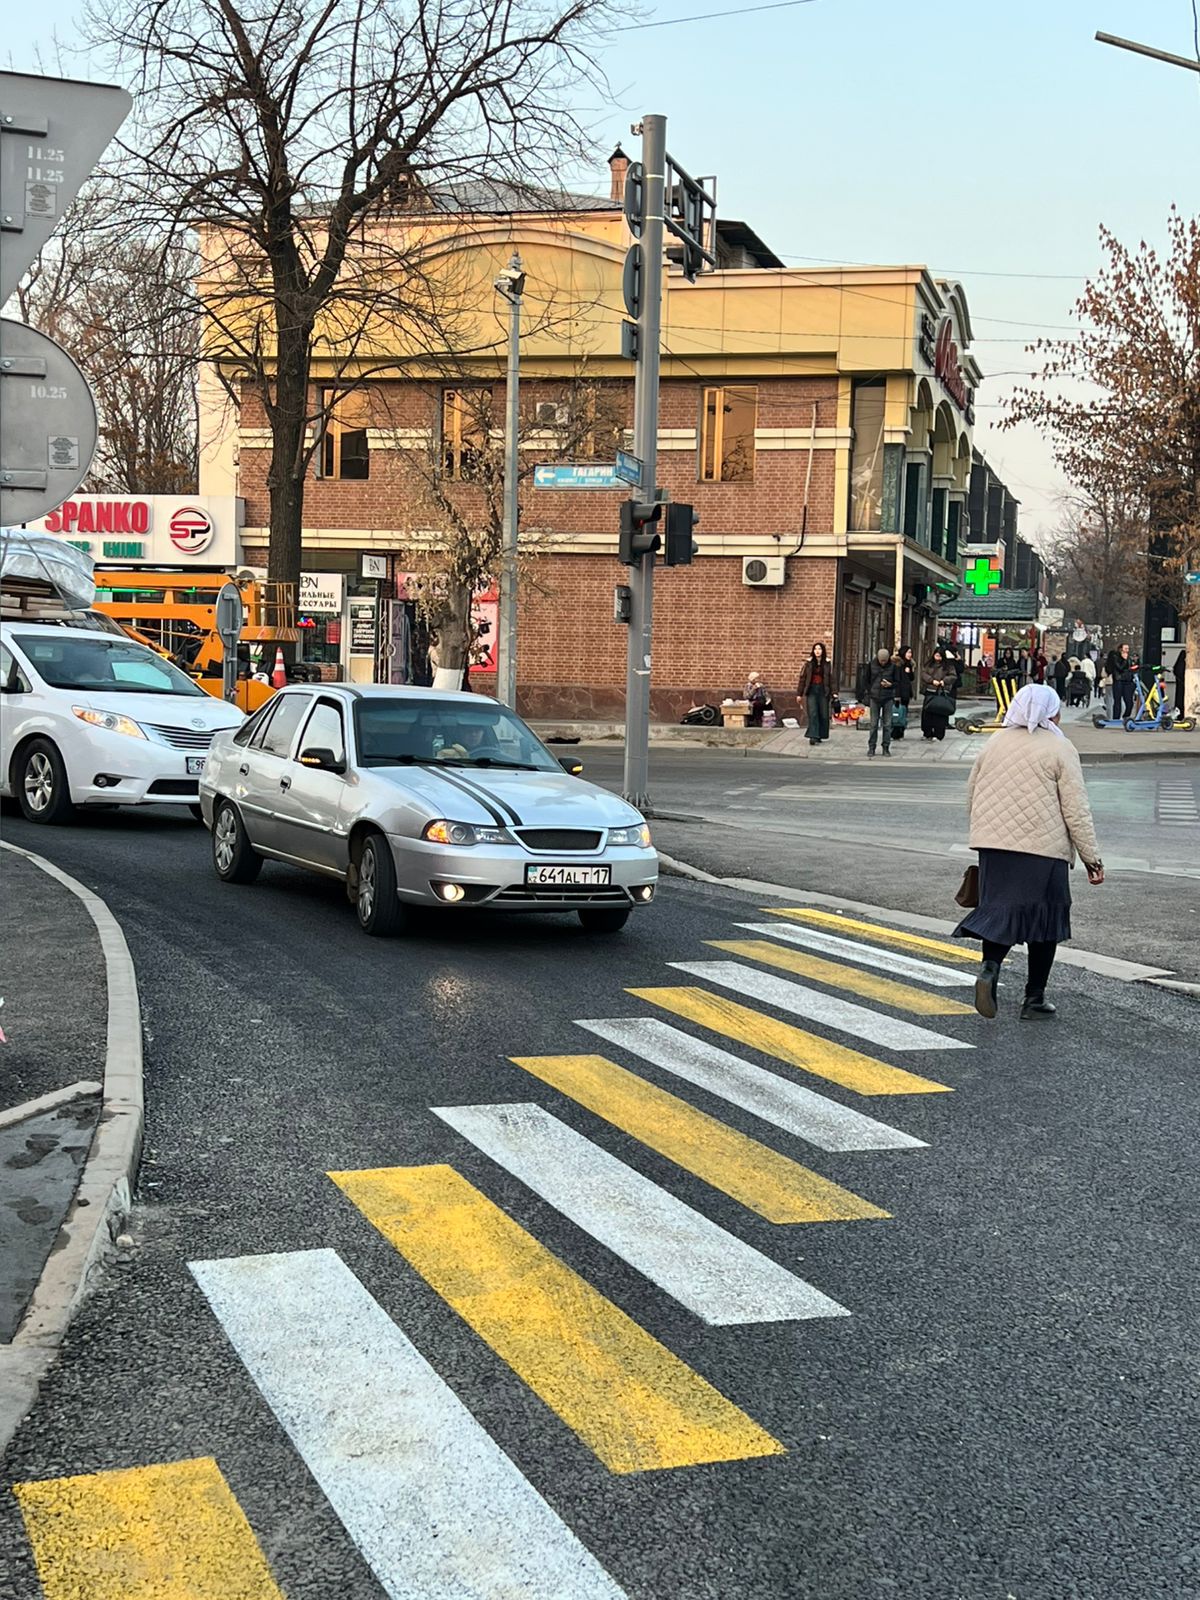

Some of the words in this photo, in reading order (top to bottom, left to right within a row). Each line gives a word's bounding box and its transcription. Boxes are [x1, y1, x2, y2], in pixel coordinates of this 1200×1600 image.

[28, 146, 64, 162] 11.25
[27, 166, 64, 183] 11.25
[31, 385, 67, 399] 10.25
[45, 501, 149, 534] SPANKO
[300, 591, 335, 600] ИЛЬНЫЕ
[299, 600, 337, 608] ЕССУАРЫ
[593, 868, 609, 884] 17
